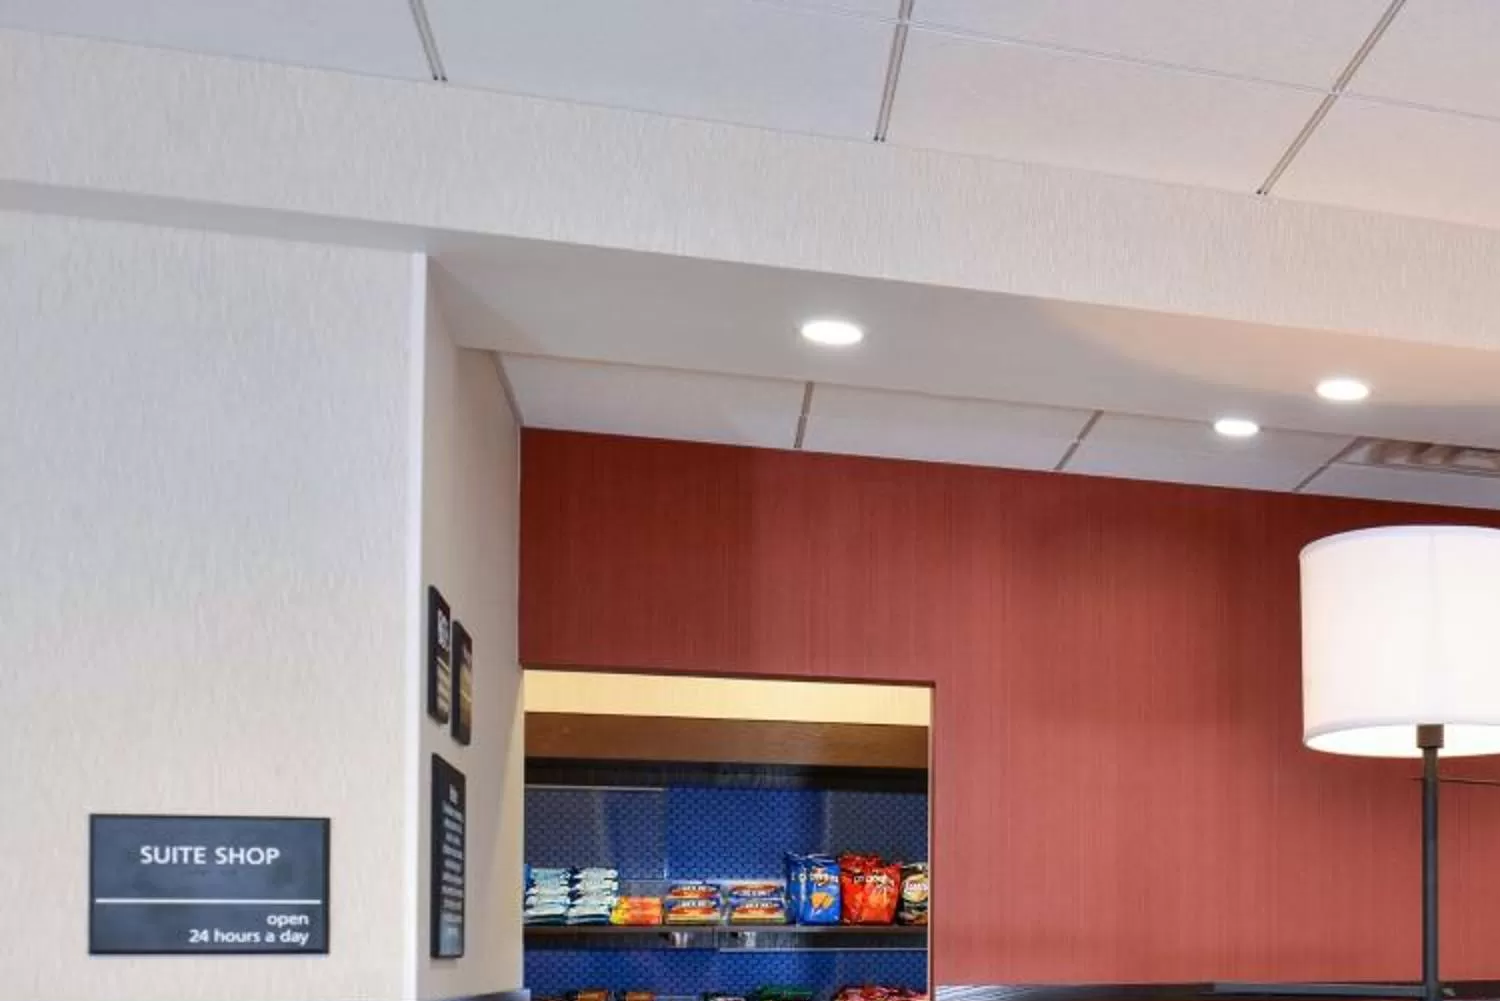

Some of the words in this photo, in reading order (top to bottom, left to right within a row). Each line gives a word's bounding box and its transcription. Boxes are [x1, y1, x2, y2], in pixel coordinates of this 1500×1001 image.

[140, 845, 207, 865] SUITE
[215, 846, 281, 866] SHOP
[266, 913, 309, 927] open
[189, 928, 209, 943] 24
[213, 928, 261, 943] hours
[265, 932, 275, 943] a
[279, 929, 309, 946] day
